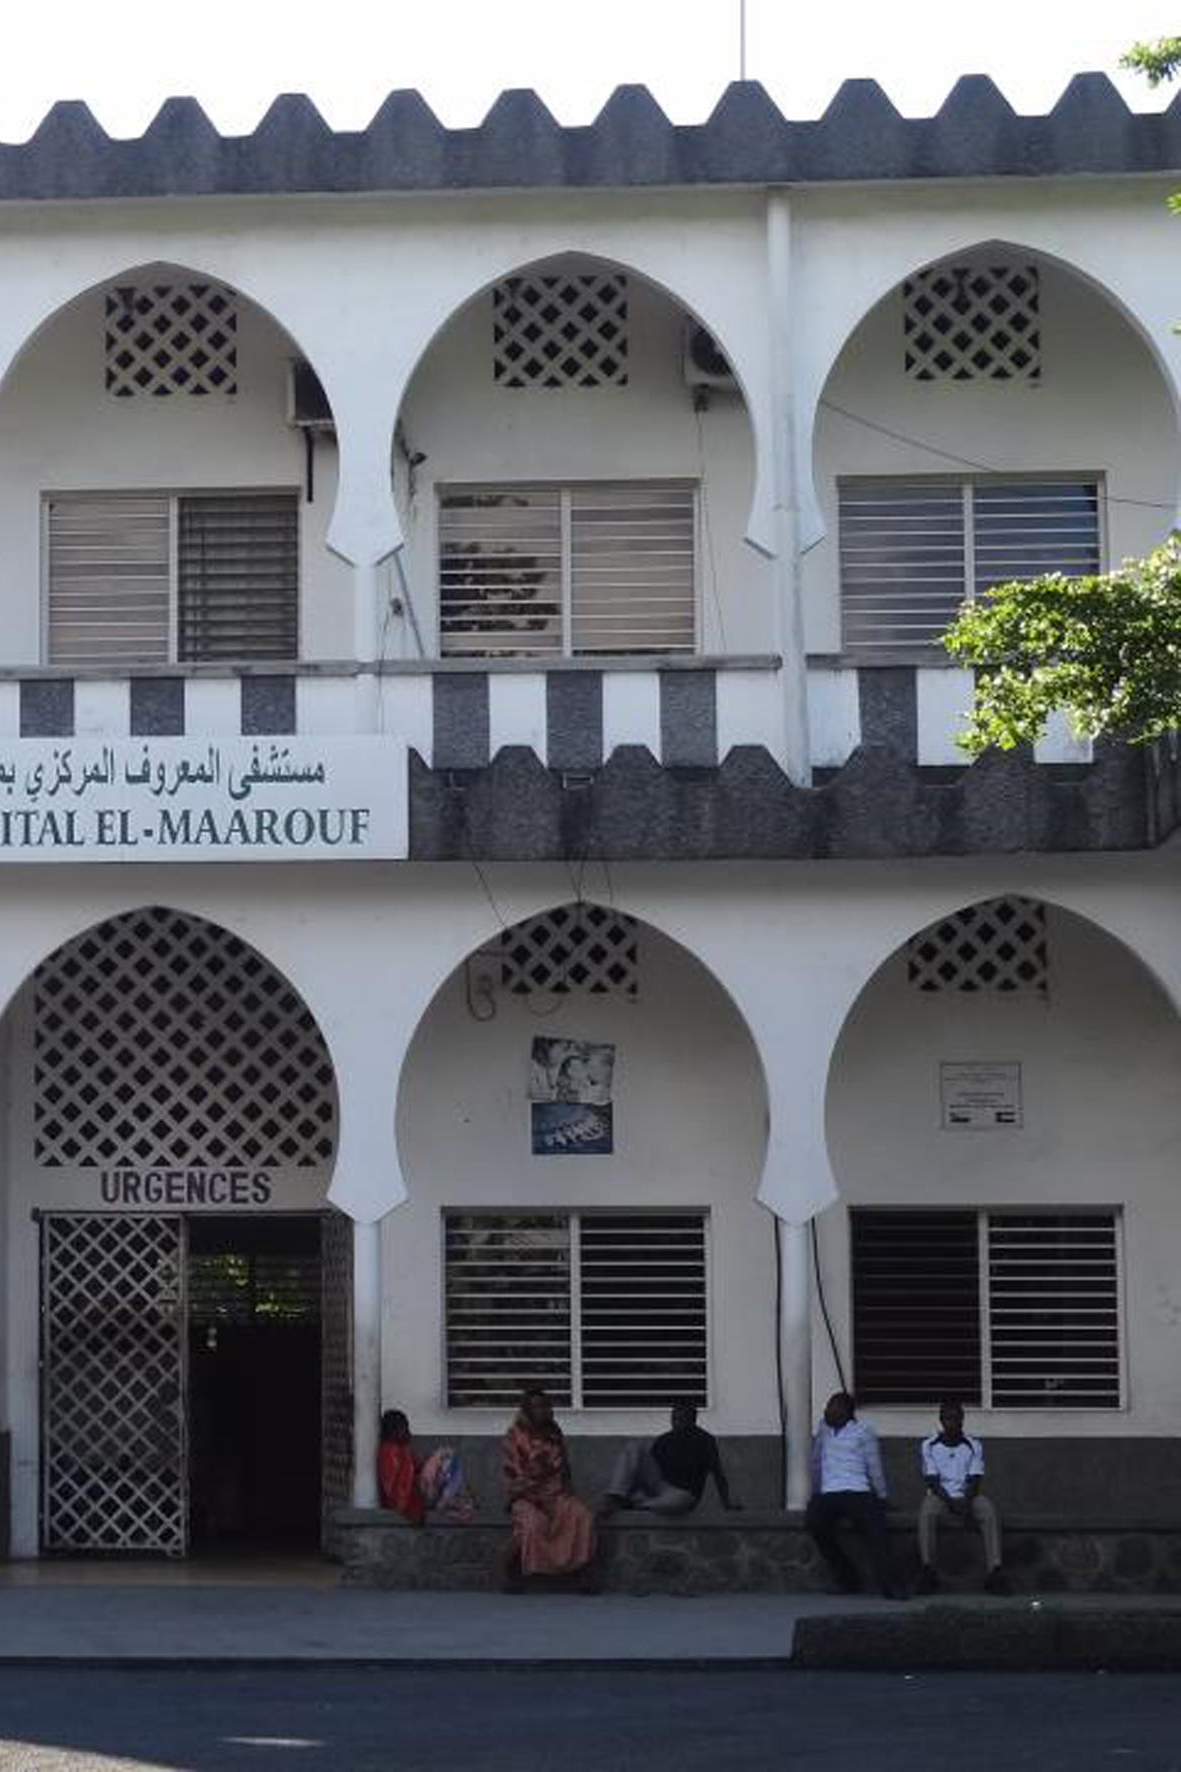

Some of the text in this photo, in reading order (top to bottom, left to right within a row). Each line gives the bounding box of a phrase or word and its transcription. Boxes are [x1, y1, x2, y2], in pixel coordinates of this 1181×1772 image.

[25, 746, 115, 803] المركزي
[124, 744, 221, 797] المعروف
[228, 744, 326, 801] مستشفى
[100, 1171, 272, 1204] URGENCES
